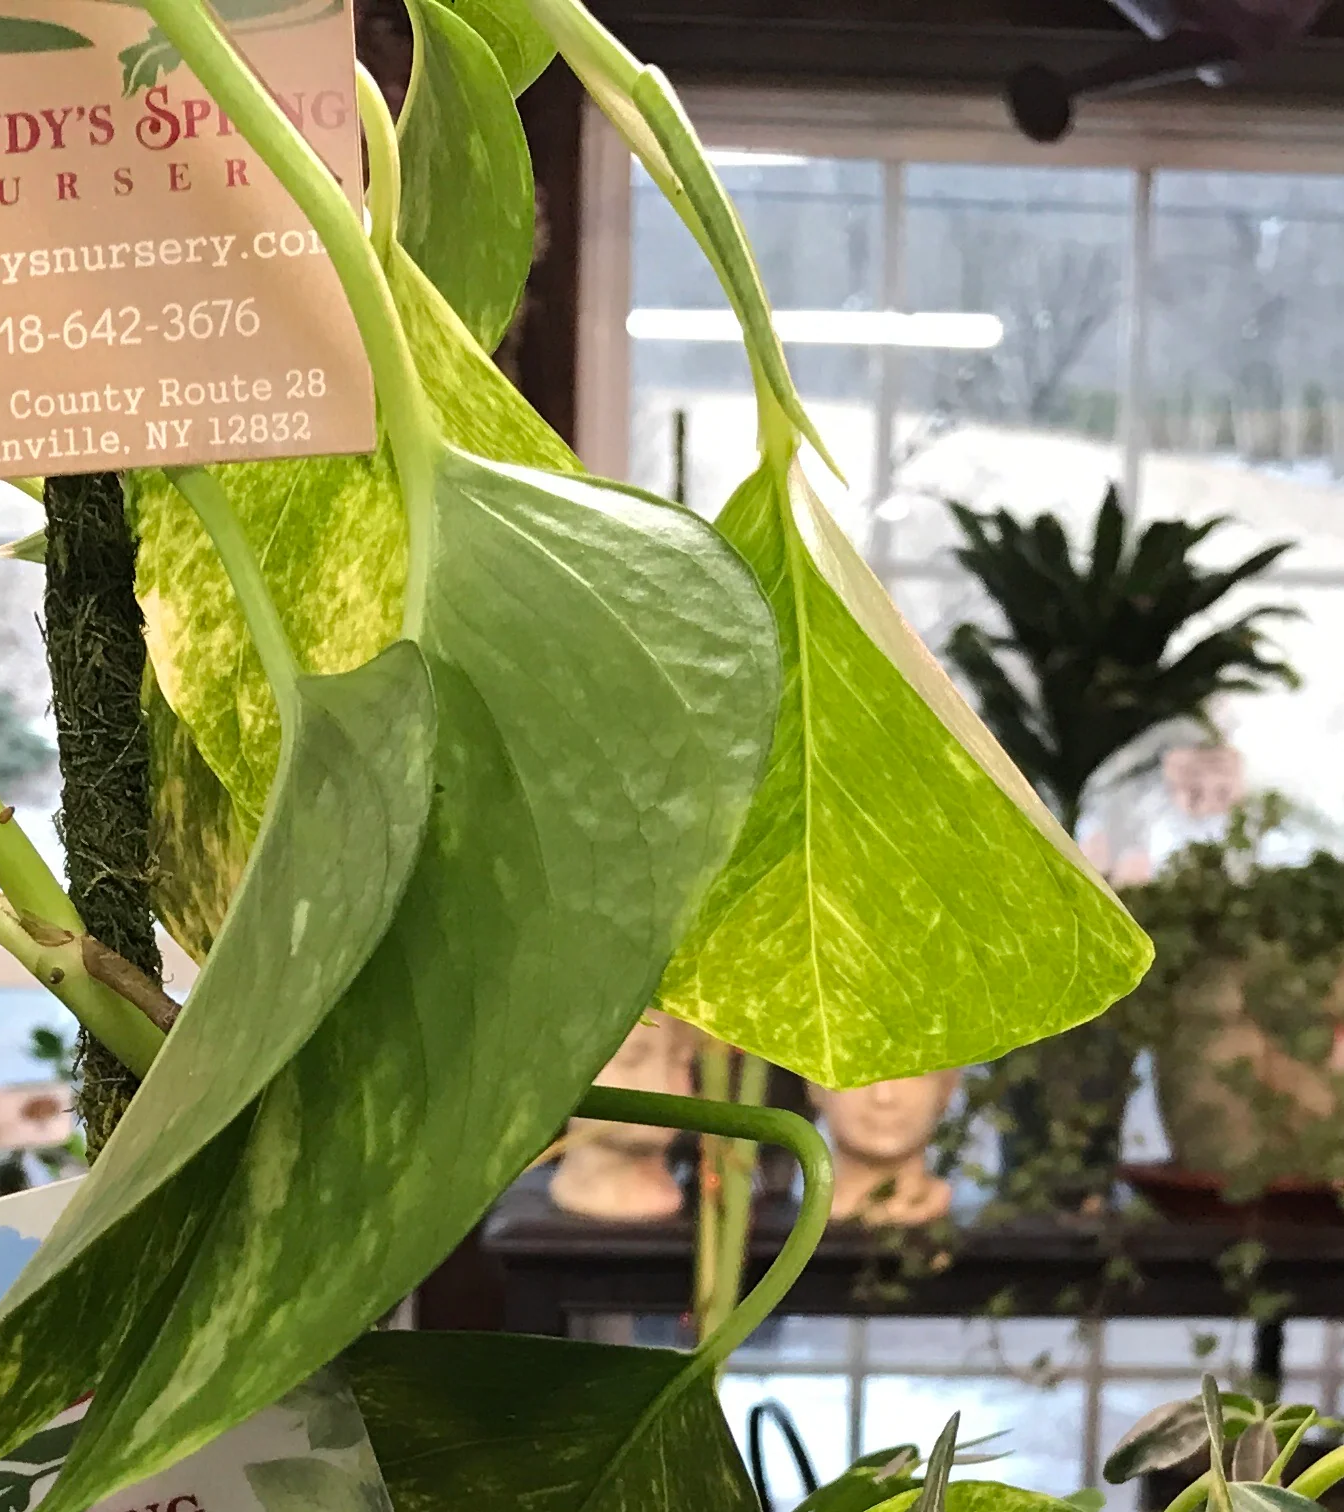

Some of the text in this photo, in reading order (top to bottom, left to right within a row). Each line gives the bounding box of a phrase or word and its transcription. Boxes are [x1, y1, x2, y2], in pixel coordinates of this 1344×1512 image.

[135, 84, 349, 151] SPNG
[10, 380, 145, 421] County
[159, 372, 273, 408] Route
[285, 368, 327, 400] 28
[146, 418, 194, 450] NY
[207, 411, 312, 445] 12832
